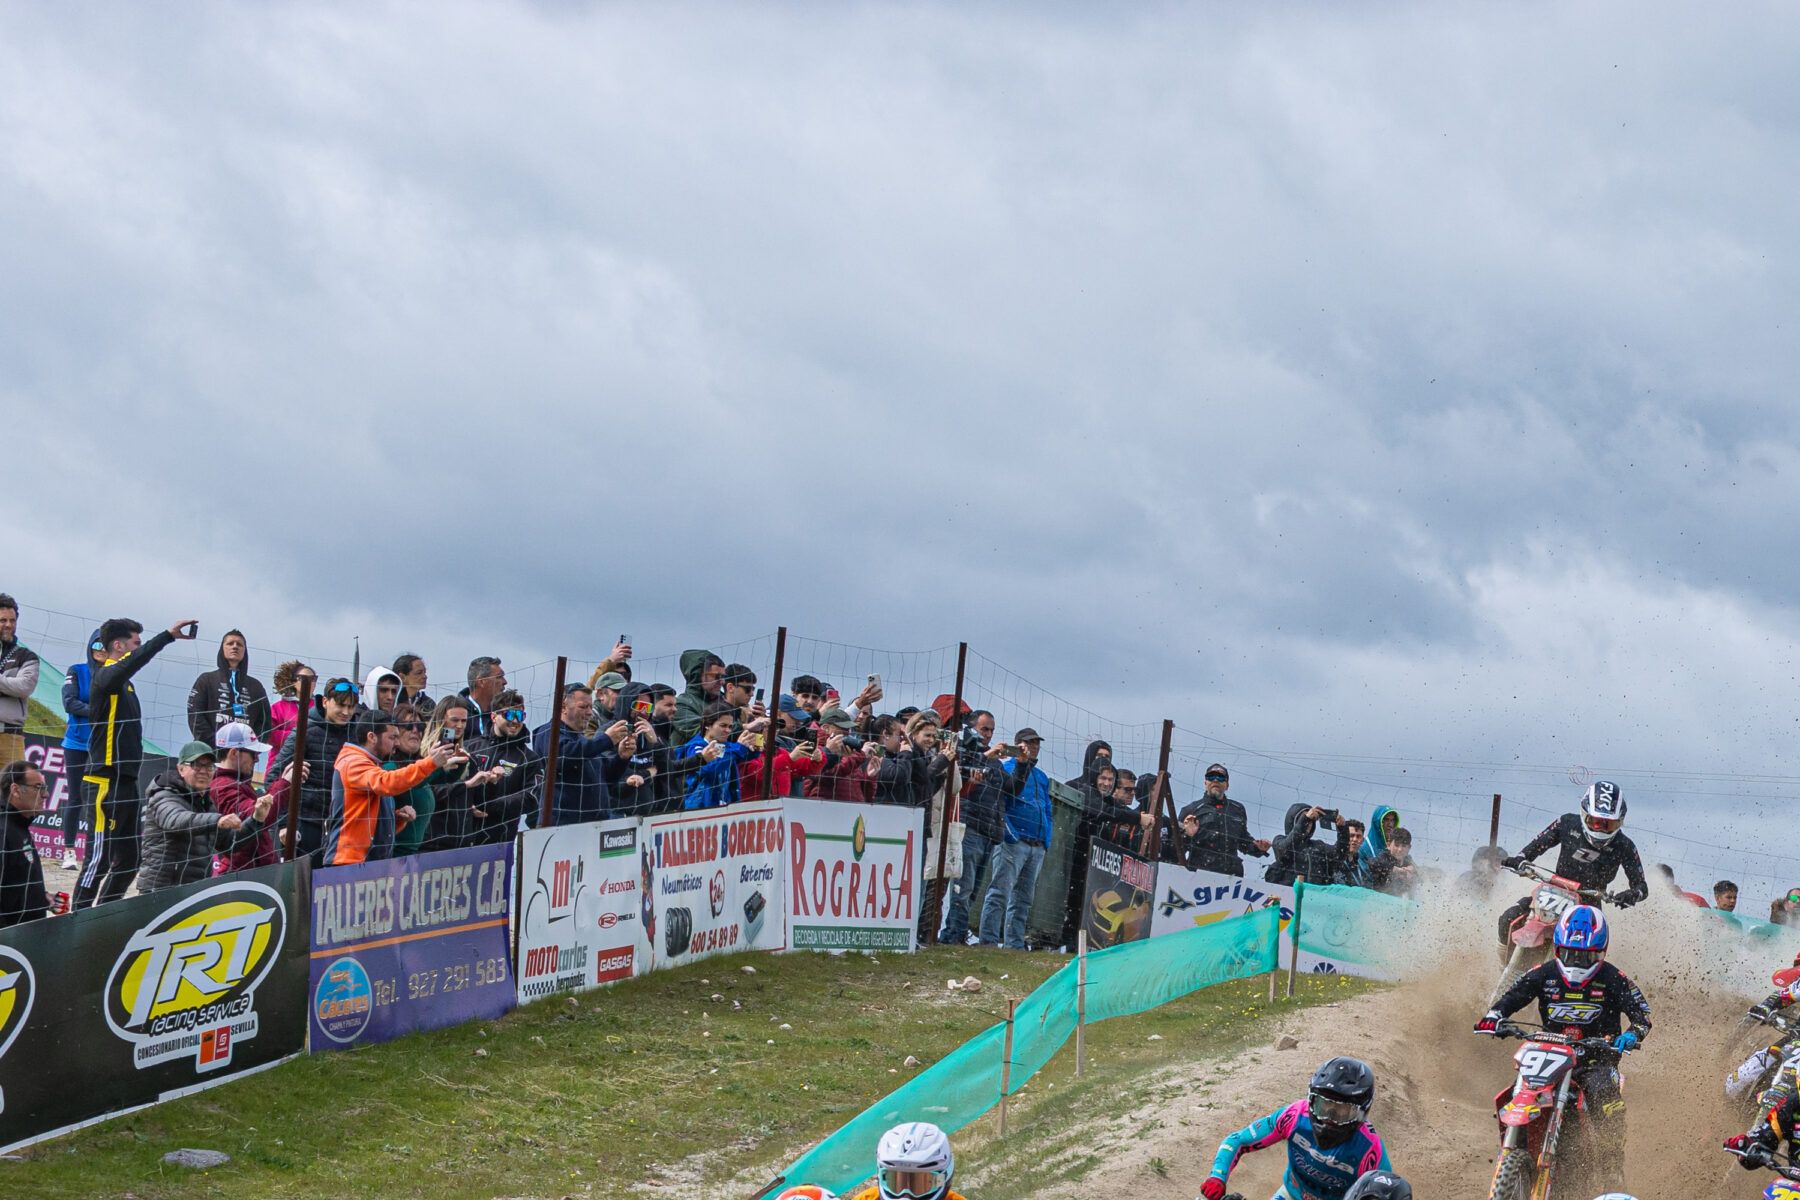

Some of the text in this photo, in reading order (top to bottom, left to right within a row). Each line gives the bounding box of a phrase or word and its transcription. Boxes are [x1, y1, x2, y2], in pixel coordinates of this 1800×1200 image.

[603, 830, 634, 849] Kawasaki
[655, 815, 785, 868] TALLERES BORREGO
[739, 863, 775, 884] Baterías
[1091, 845, 1122, 876] TALLERES
[607, 879, 636, 894] HONDA
[661, 871, 703, 896] Neumáticos
[314, 860, 507, 946] TALLERES CACERES C.B.
[690, 923, 739, 955] 600 54 89 89
[123, 907, 278, 1029] TRT
[599, 953, 633, 972] GASGAS
[373, 976, 400, 1008] Tel.
[408, 969, 438, 1001] 927
[443, 963, 471, 994] 291
[475, 957, 507, 987] 583
[150, 994, 251, 1036] racing service
[1549, 1003, 1602, 1022] TRT
[230, 1019, 256, 1036] SEVILLA
[137, 1033, 201, 1061] CONCESIONARIO OFICIAL
[1519, 1050, 1569, 1078] 97
[1292, 1132, 1355, 1175] Beta
